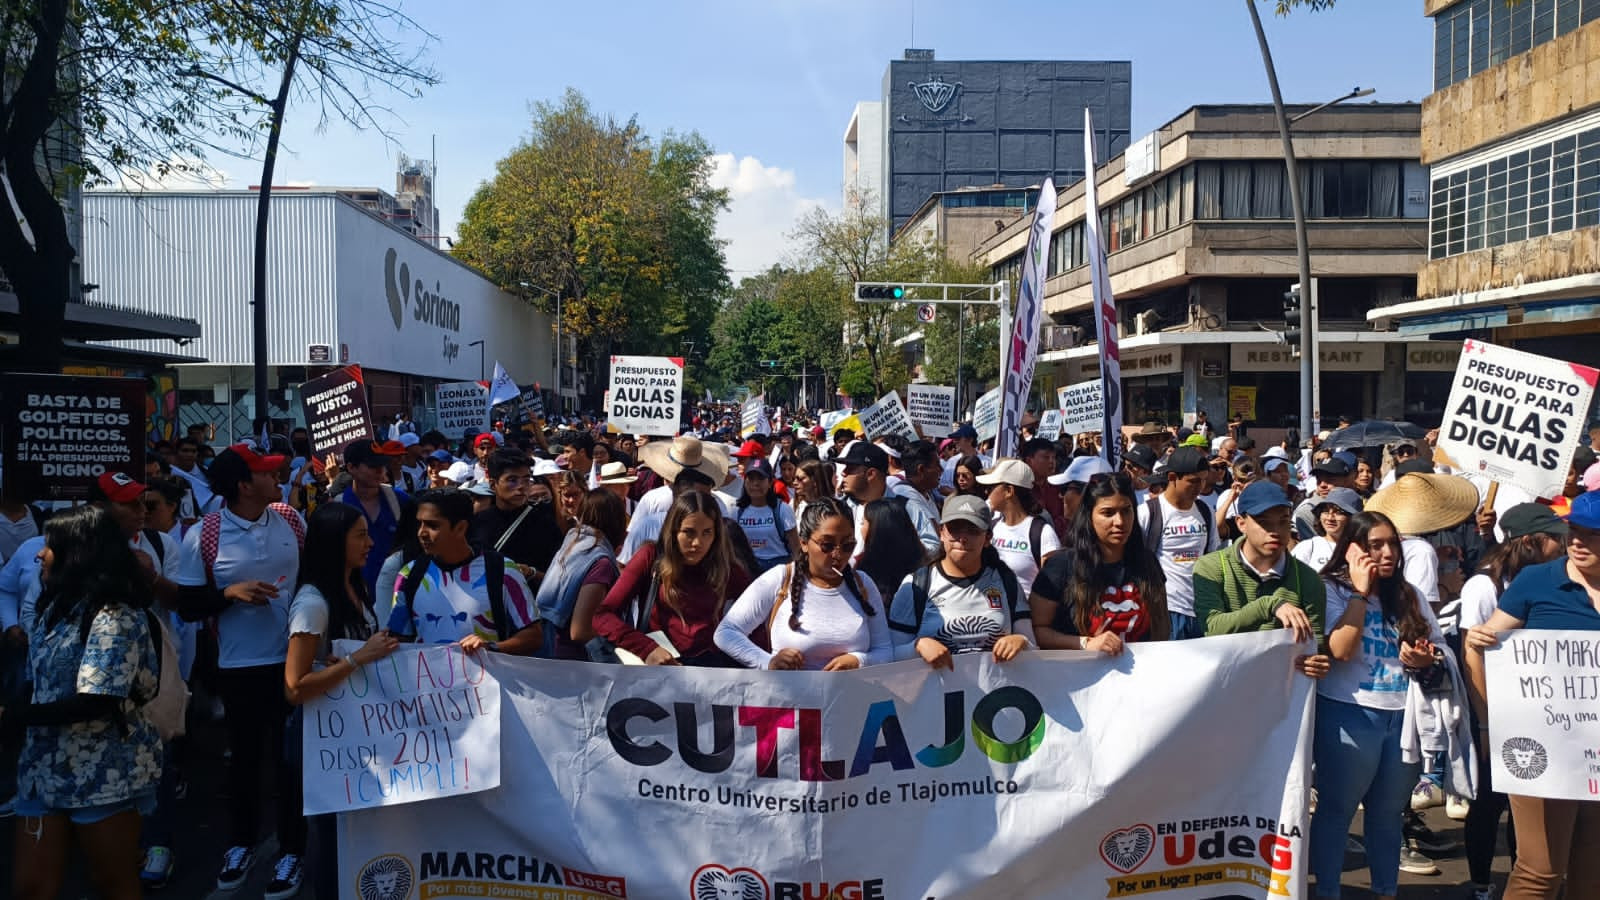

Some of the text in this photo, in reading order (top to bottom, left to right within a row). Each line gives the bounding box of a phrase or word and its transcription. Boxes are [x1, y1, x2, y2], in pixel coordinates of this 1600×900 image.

[414, 280, 460, 332] Soriana
[615, 366, 676, 376] PRESUPUESTO
[1468, 359, 1580, 397] PRESUPUESTO
[614, 377, 676, 387] DIGNO, PARA
[306, 381, 358, 406] PRESUPUESTO
[439, 388, 486, 399] LEONAS Y
[614, 388, 675, 404] AULAS
[1064, 384, 1101, 398] POR MÁS
[1462, 376, 1574, 416] DIGNO, PARA
[28, 394, 121, 409] BASTA DE
[316, 394, 352, 415] JUSTO.
[440, 399, 486, 408] LEONES EN
[1067, 402, 1104, 416] POR MÁS
[18, 410, 130, 425] GOLPETEOS
[311, 408, 362, 431] POR LAS AULAS
[440, 408, 486, 418] DEFENSA DE
[613, 404, 674, 420] DIGNAS
[864, 400, 898, 426] NI UN PASO
[884, 413, 894, 423] EN
[892, 407, 902, 416] LA
[910, 412, 950, 420] AUTONOMÍA
[1065, 412, 1104, 425] EDUCACIÓ
[1456, 395, 1566, 444] AULAS
[444, 418, 484, 428] LA UDEG
[22, 425, 126, 441] POLÍTICOS.
[314, 430, 330, 440] PARA
[315, 427, 366, 451] HIJAS E HIJOS
[18, 441, 29, 451] SÍ
[42, 444, 57, 452] LA
[60, 443, 130, 454] EDUCACIÓN,
[1448, 420, 1560, 470] DIGNAS
[18, 450, 130, 462] SÍ AL PRESUPUESTO
[42, 464, 106, 476] DIGNO
[1163, 525, 1208, 536] CUTLAJO
[1513, 639, 1548, 664] HOY
[1520, 676, 1554, 700] MIS
[317, 686, 489, 739] LO PROMETISTE
[1544, 704, 1598, 731] Soy una
[606, 685, 1047, 782] CUTLAJO
[392, 726, 454, 766] 2011
[638, 776, 1018, 814] Centro Universitario de Tlajomulco
[1157, 816, 1301, 838] EN DEFENSA DE LA
[1164, 830, 1292, 870] UdeG
[420, 852, 562, 886] MARCHA
[1116, 880, 1137, 893] Por
[1142, 878, 1156, 888] un
[1160, 872, 1190, 888] lugar
[1194, 870, 1222, 885] para
[1226, 868, 1248, 878] tus
[428, 884, 449, 896] Por
[455, 884, 483, 894] más
[487, 884, 539, 898] jóvenes
[544, 889, 560, 900] en
